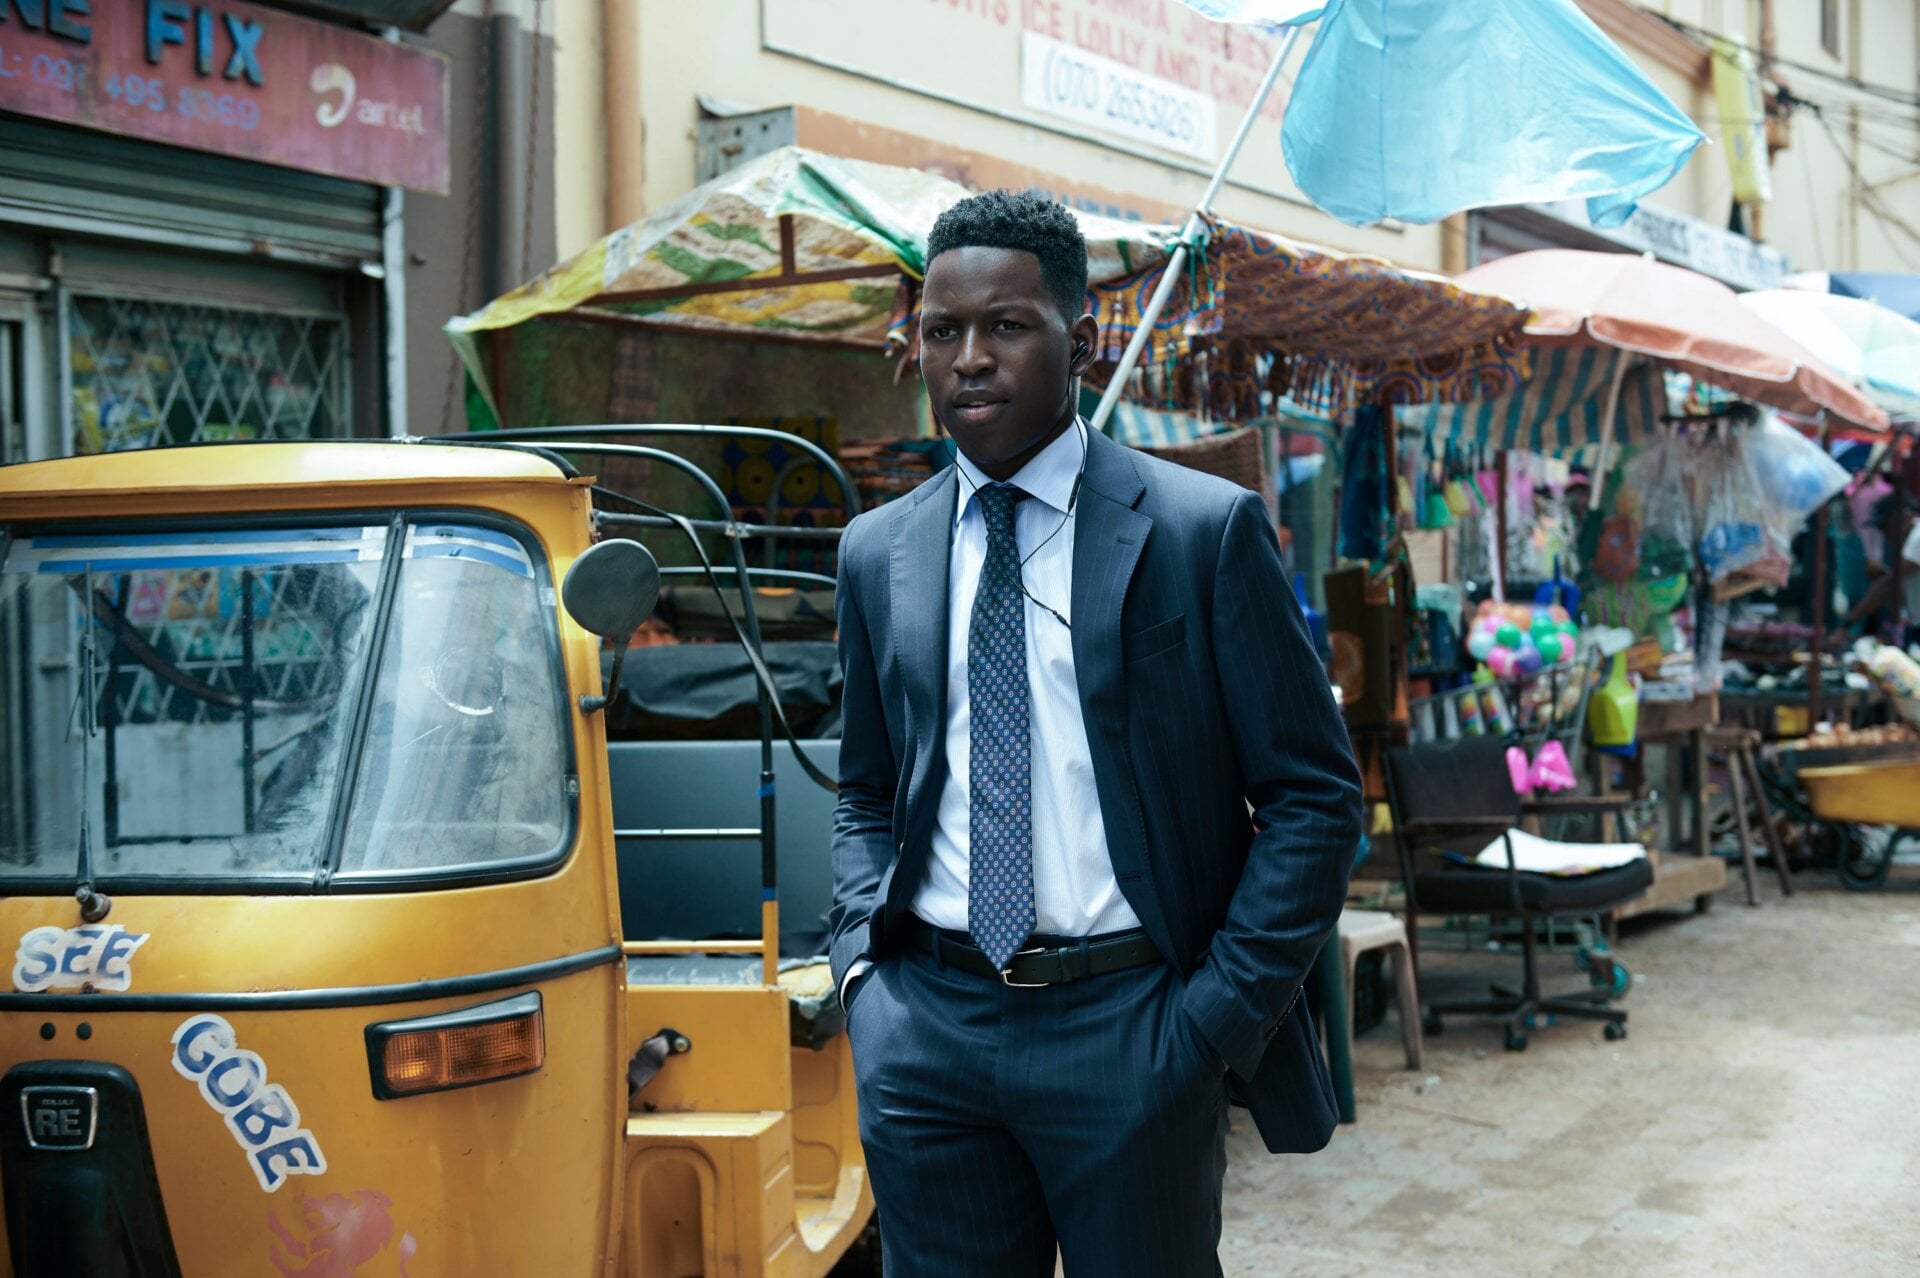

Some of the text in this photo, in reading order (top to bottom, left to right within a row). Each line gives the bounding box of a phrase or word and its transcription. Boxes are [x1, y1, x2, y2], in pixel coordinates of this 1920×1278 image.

[146, 0, 264, 86] FIX
[1074, 11, 1145, 68] LOLLY
[105, 72, 166, 112] 495
[17, 928, 146, 987] SEE
[34, 1108, 82, 1136] RE
[175, 1018, 323, 1188] GOBE
